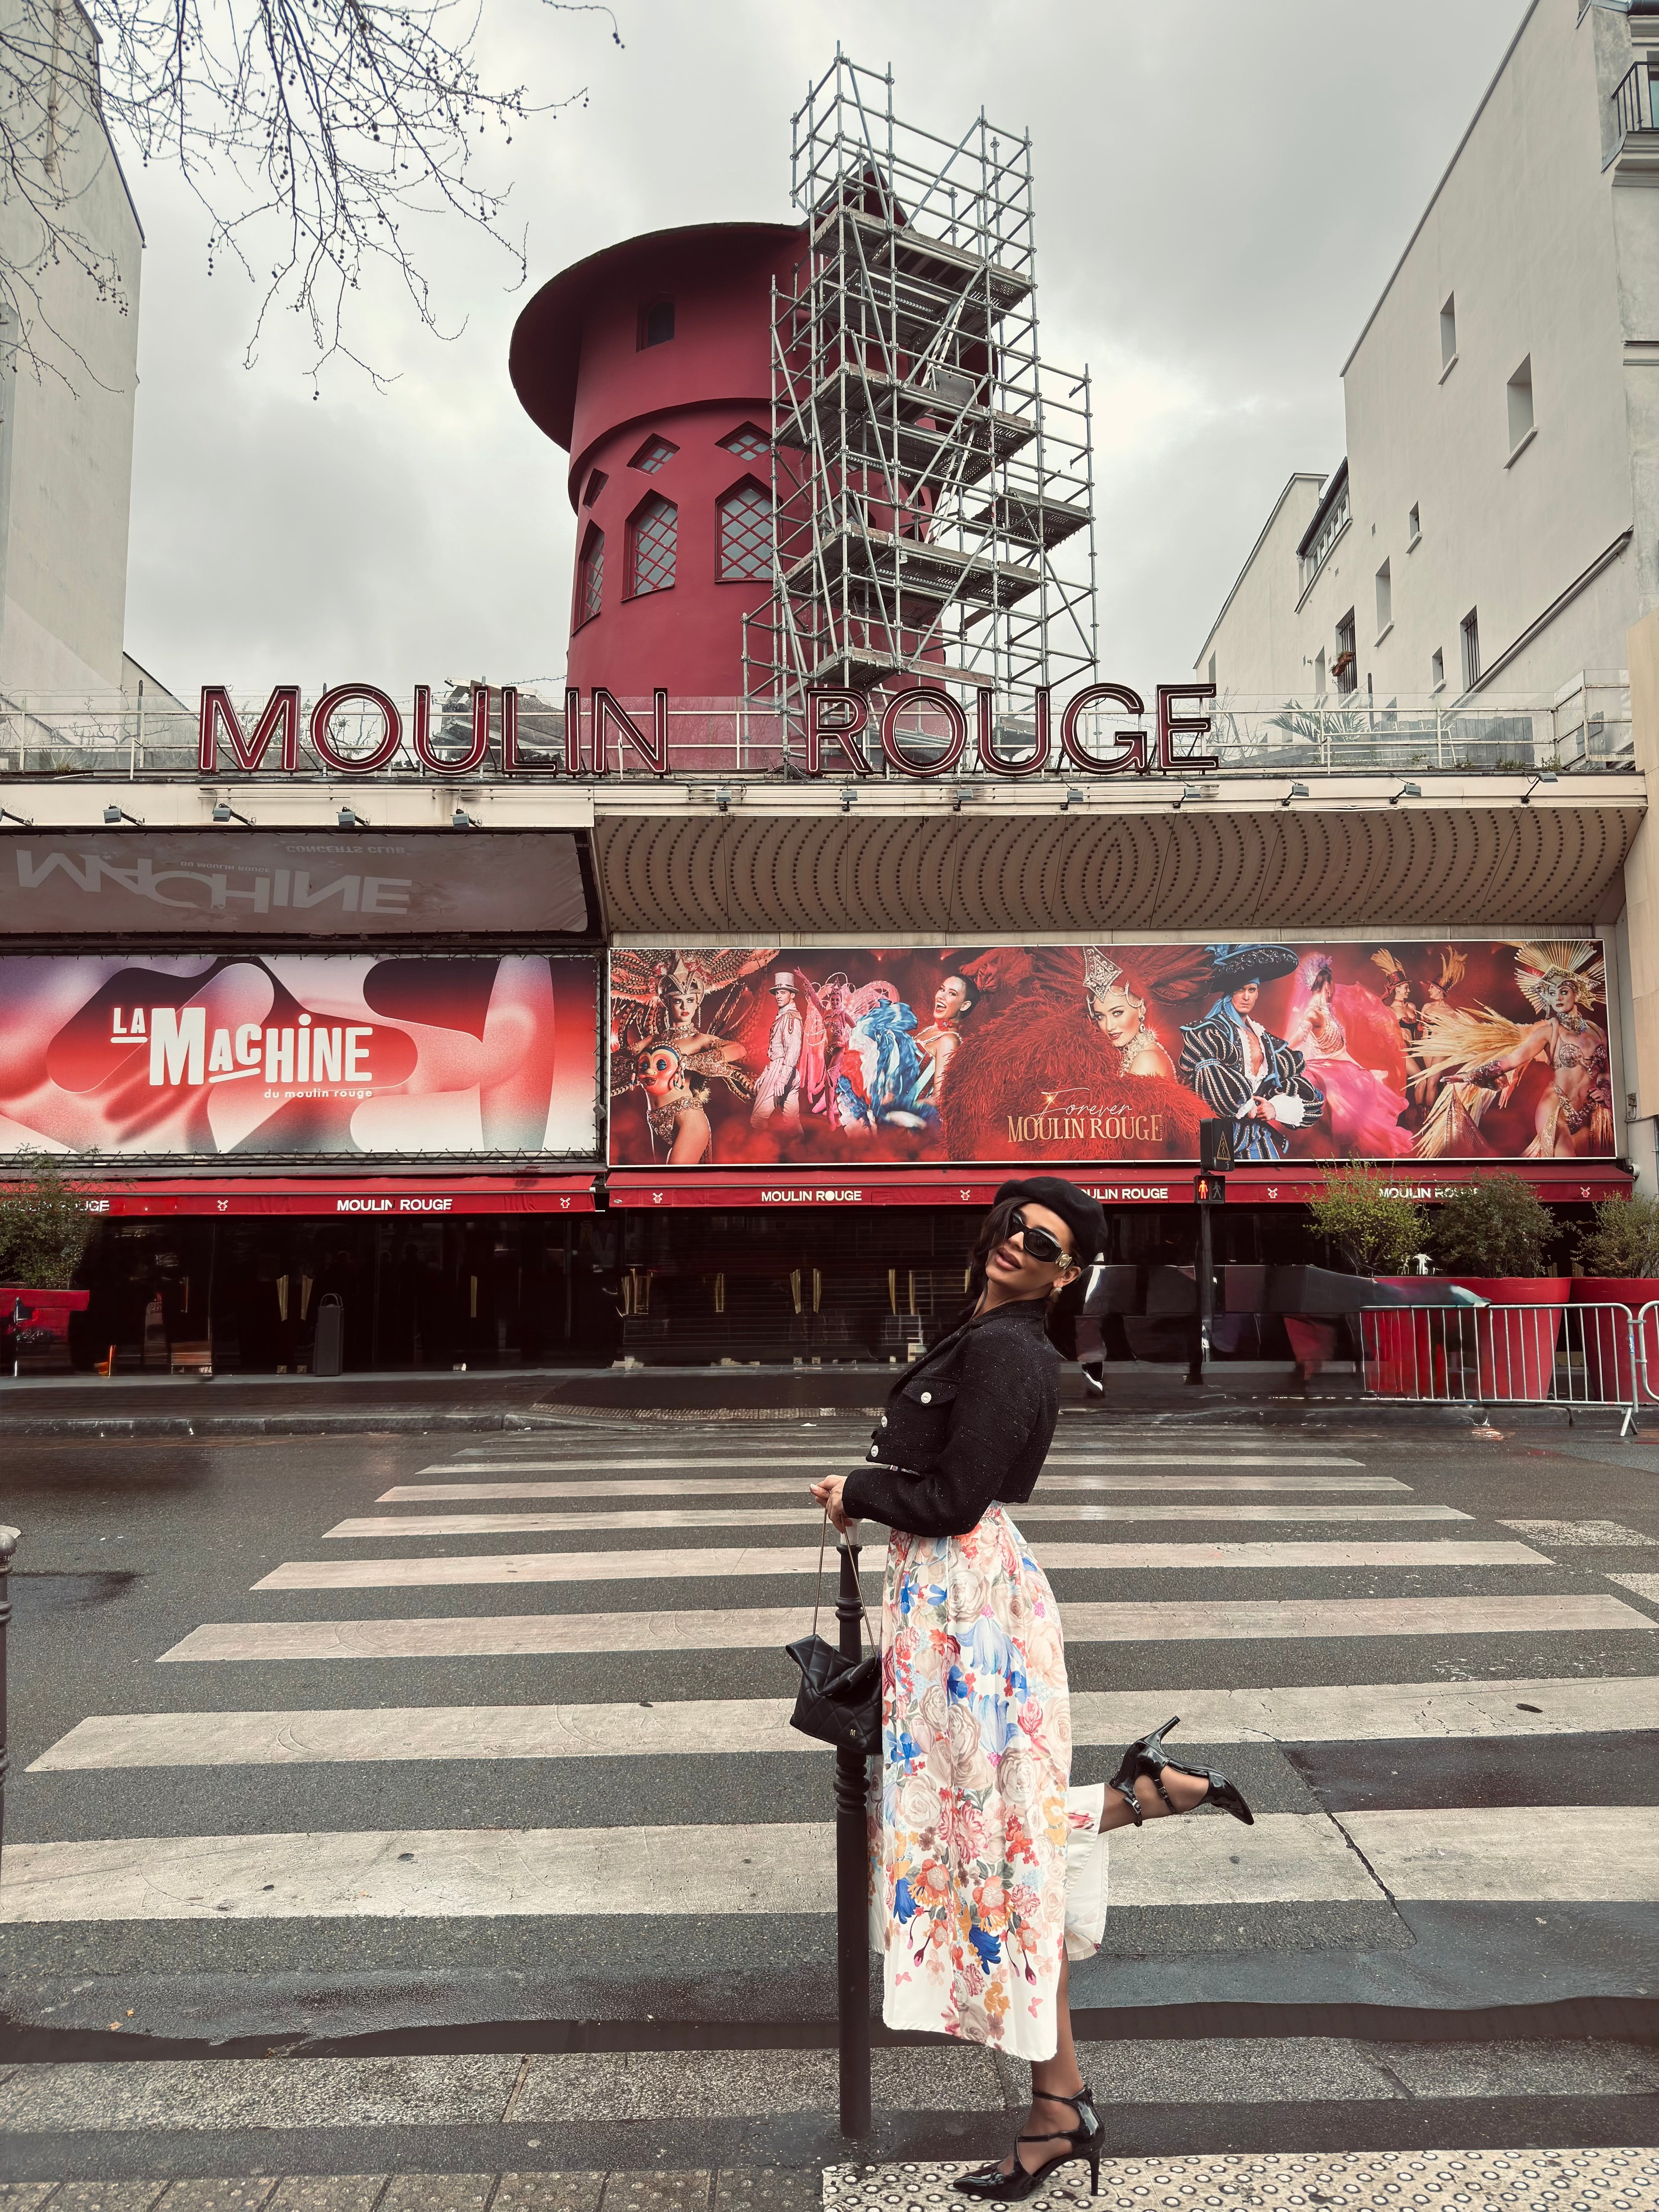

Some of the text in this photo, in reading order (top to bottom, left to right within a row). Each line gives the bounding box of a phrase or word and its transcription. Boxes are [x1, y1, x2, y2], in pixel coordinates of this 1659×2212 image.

[198, 683, 1219, 776] MOULIN ROUGE
[113, 1007, 146, 1034] LA
[264, 1088, 372, 1099] du moulin rouge
[1030, 1087, 1133, 1126] Forever
[1007, 1115, 1163, 1143] MOULIN ROUGE
[761, 1190, 862, 1201] MOULIN ROUGE
[1122, 1188, 1168, 1199] ROUGE
[1379, 1188, 1431, 1198] MOULIN
[337, 1199, 453, 1211] MOULIN ROUGE
